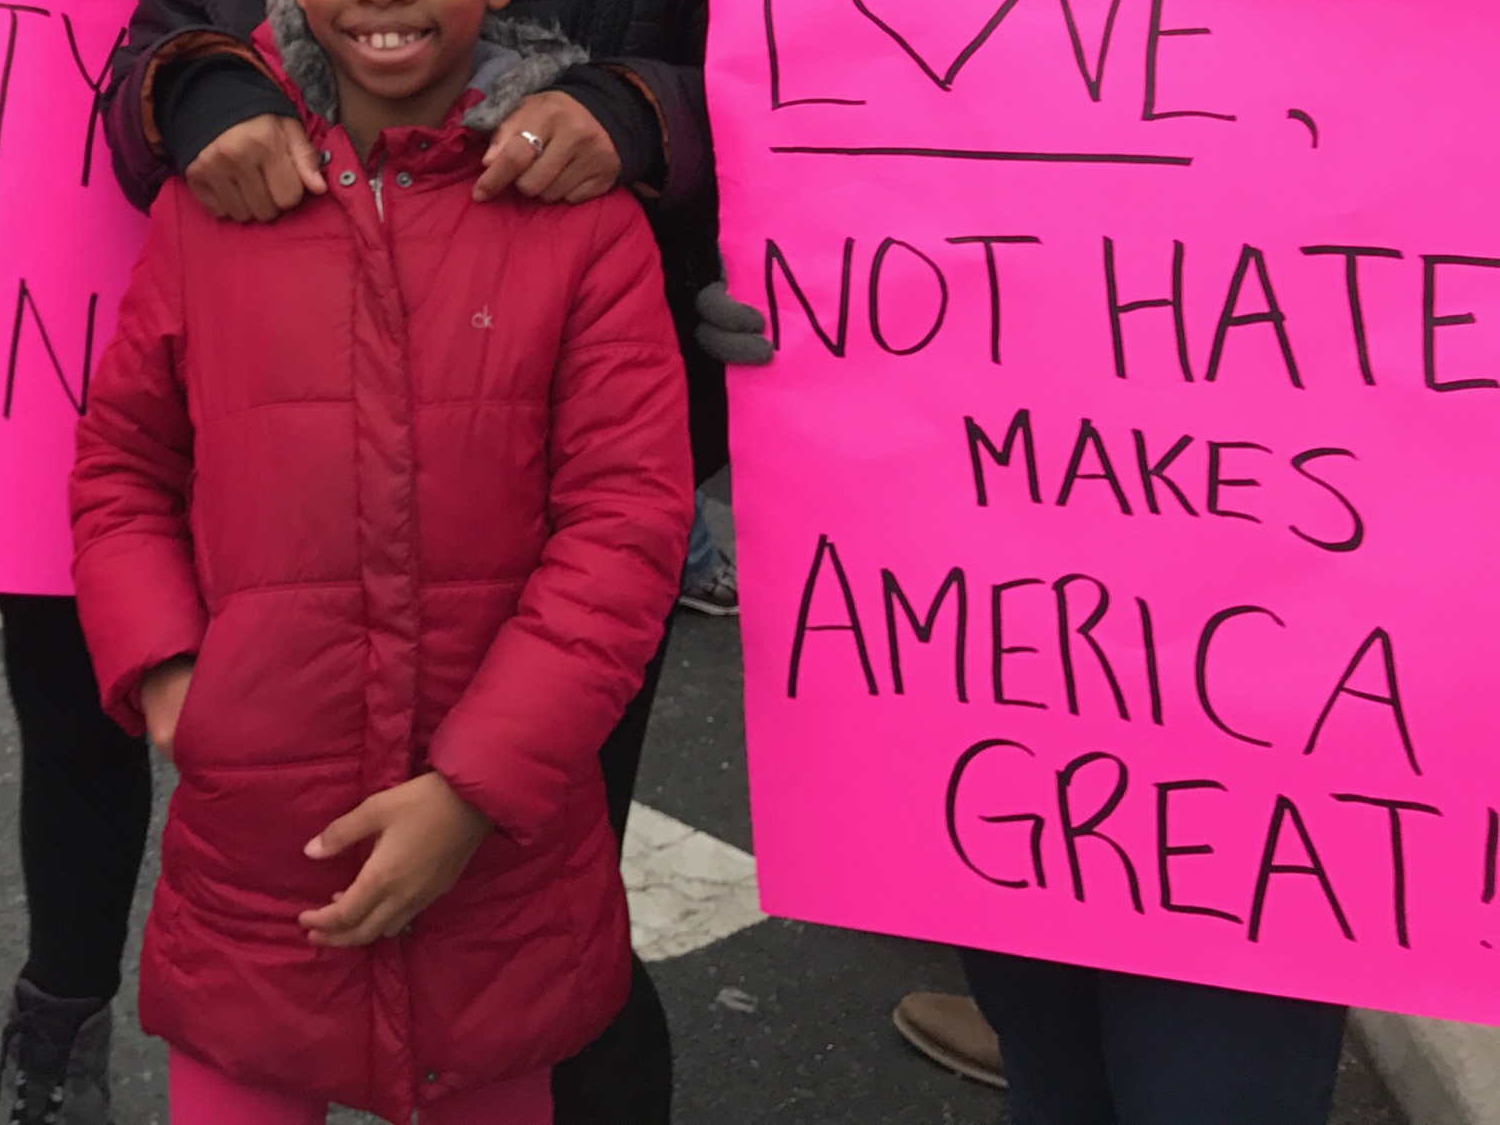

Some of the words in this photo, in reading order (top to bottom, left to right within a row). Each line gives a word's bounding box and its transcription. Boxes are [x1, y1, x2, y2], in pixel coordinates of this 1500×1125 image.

[764, 236, 1044, 365] NOT
[1102, 235, 1500, 391] HATE
[963, 408, 1364, 553] MAKES
[786, 533, 1423, 777] AMERICA
[945, 738, 1499, 949] GREAT!
